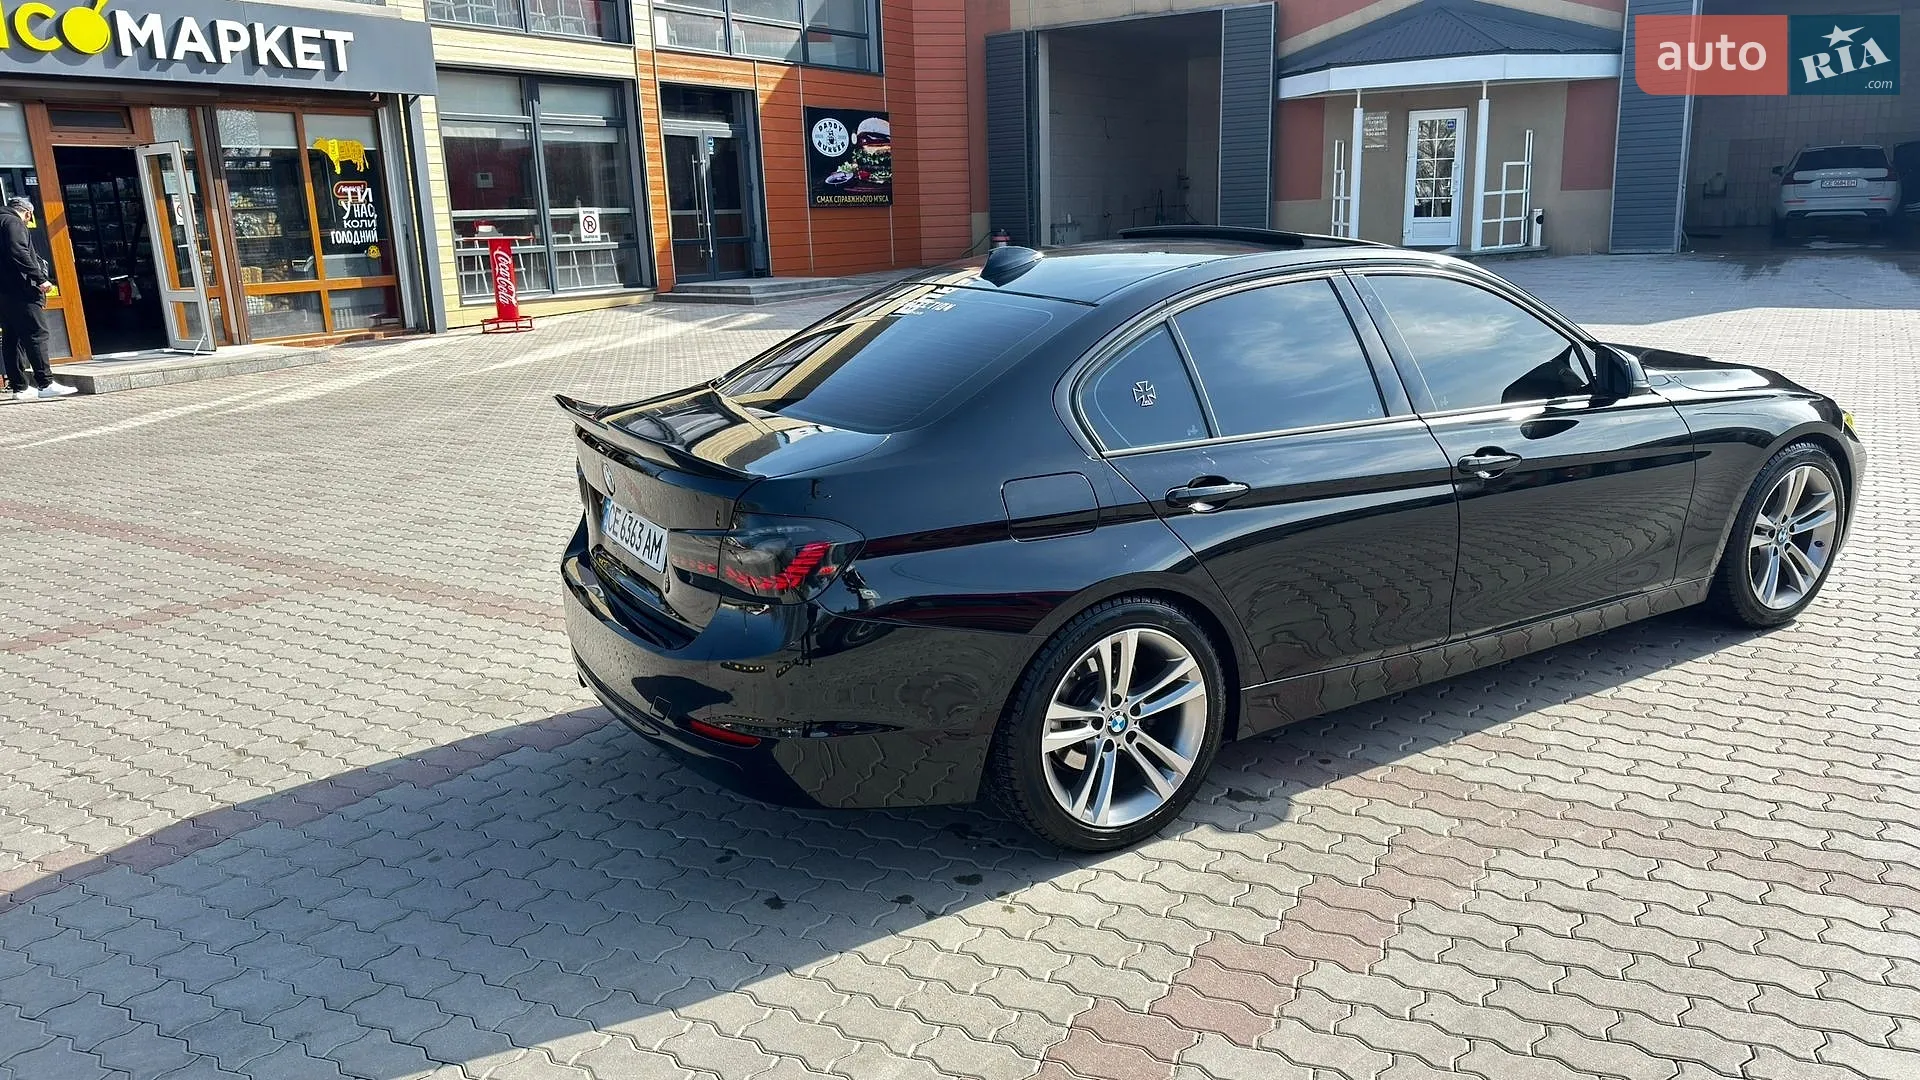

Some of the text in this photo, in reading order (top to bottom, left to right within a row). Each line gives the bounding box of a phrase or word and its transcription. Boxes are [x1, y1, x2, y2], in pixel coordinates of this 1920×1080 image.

[818, 121, 843, 132] DADDY
[817, 140, 845, 153] BURGER
[816, 195, 833, 203] СМАК
[330, 229, 378, 245] ГОЛОДНИЙ
[620, 513, 645, 551] 6363
[642, 528, 664, 564] AM
